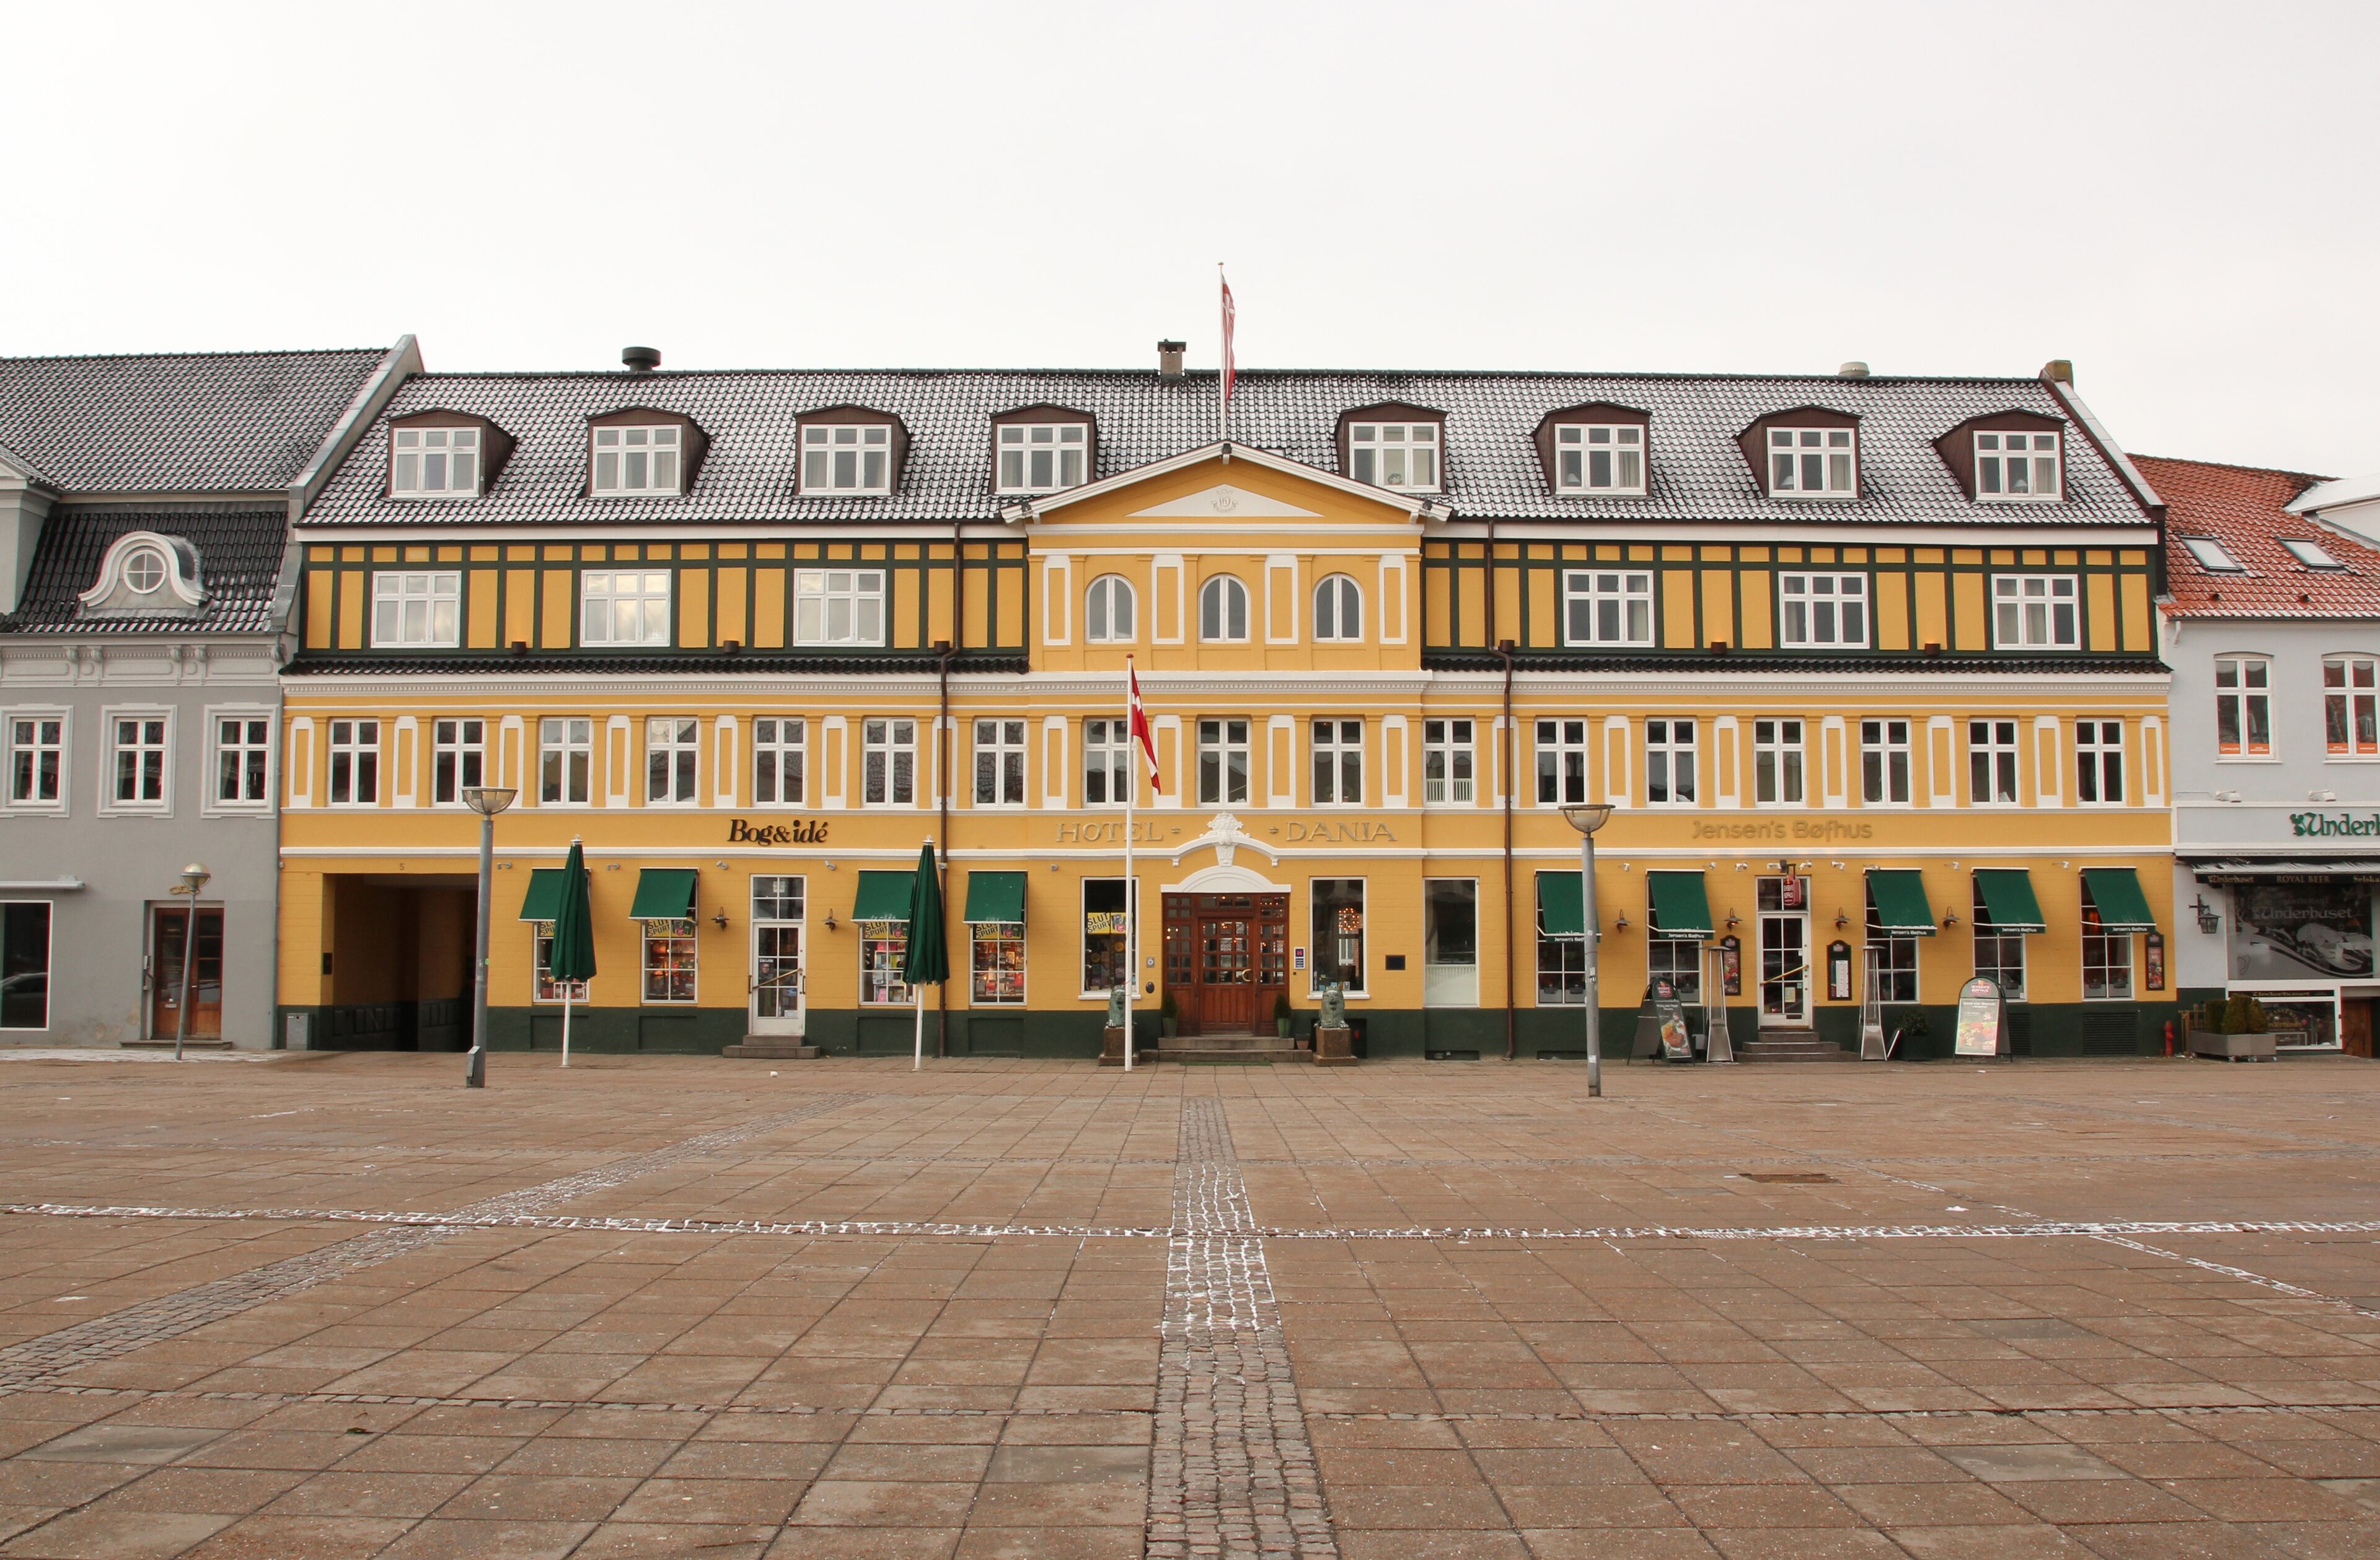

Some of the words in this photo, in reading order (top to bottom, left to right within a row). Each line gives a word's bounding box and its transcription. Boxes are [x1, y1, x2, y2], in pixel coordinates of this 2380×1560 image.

[727, 819, 828, 846] Bog&idé
[1056, 822, 1163, 842] HOTEL
[1286, 821, 1398, 842] DANIA
[1693, 820, 1786, 839] Jensen's
[1792, 820, 1872, 842] Bøfhus
[2211, 875, 2254, 883] Underhuset
[2276, 875, 2306, 883] ROYAL
[2308, 875, 2331, 883] BEER
[1087, 912, 1108, 926] SLUT
[2260, 907, 2353, 919] Underhuset
